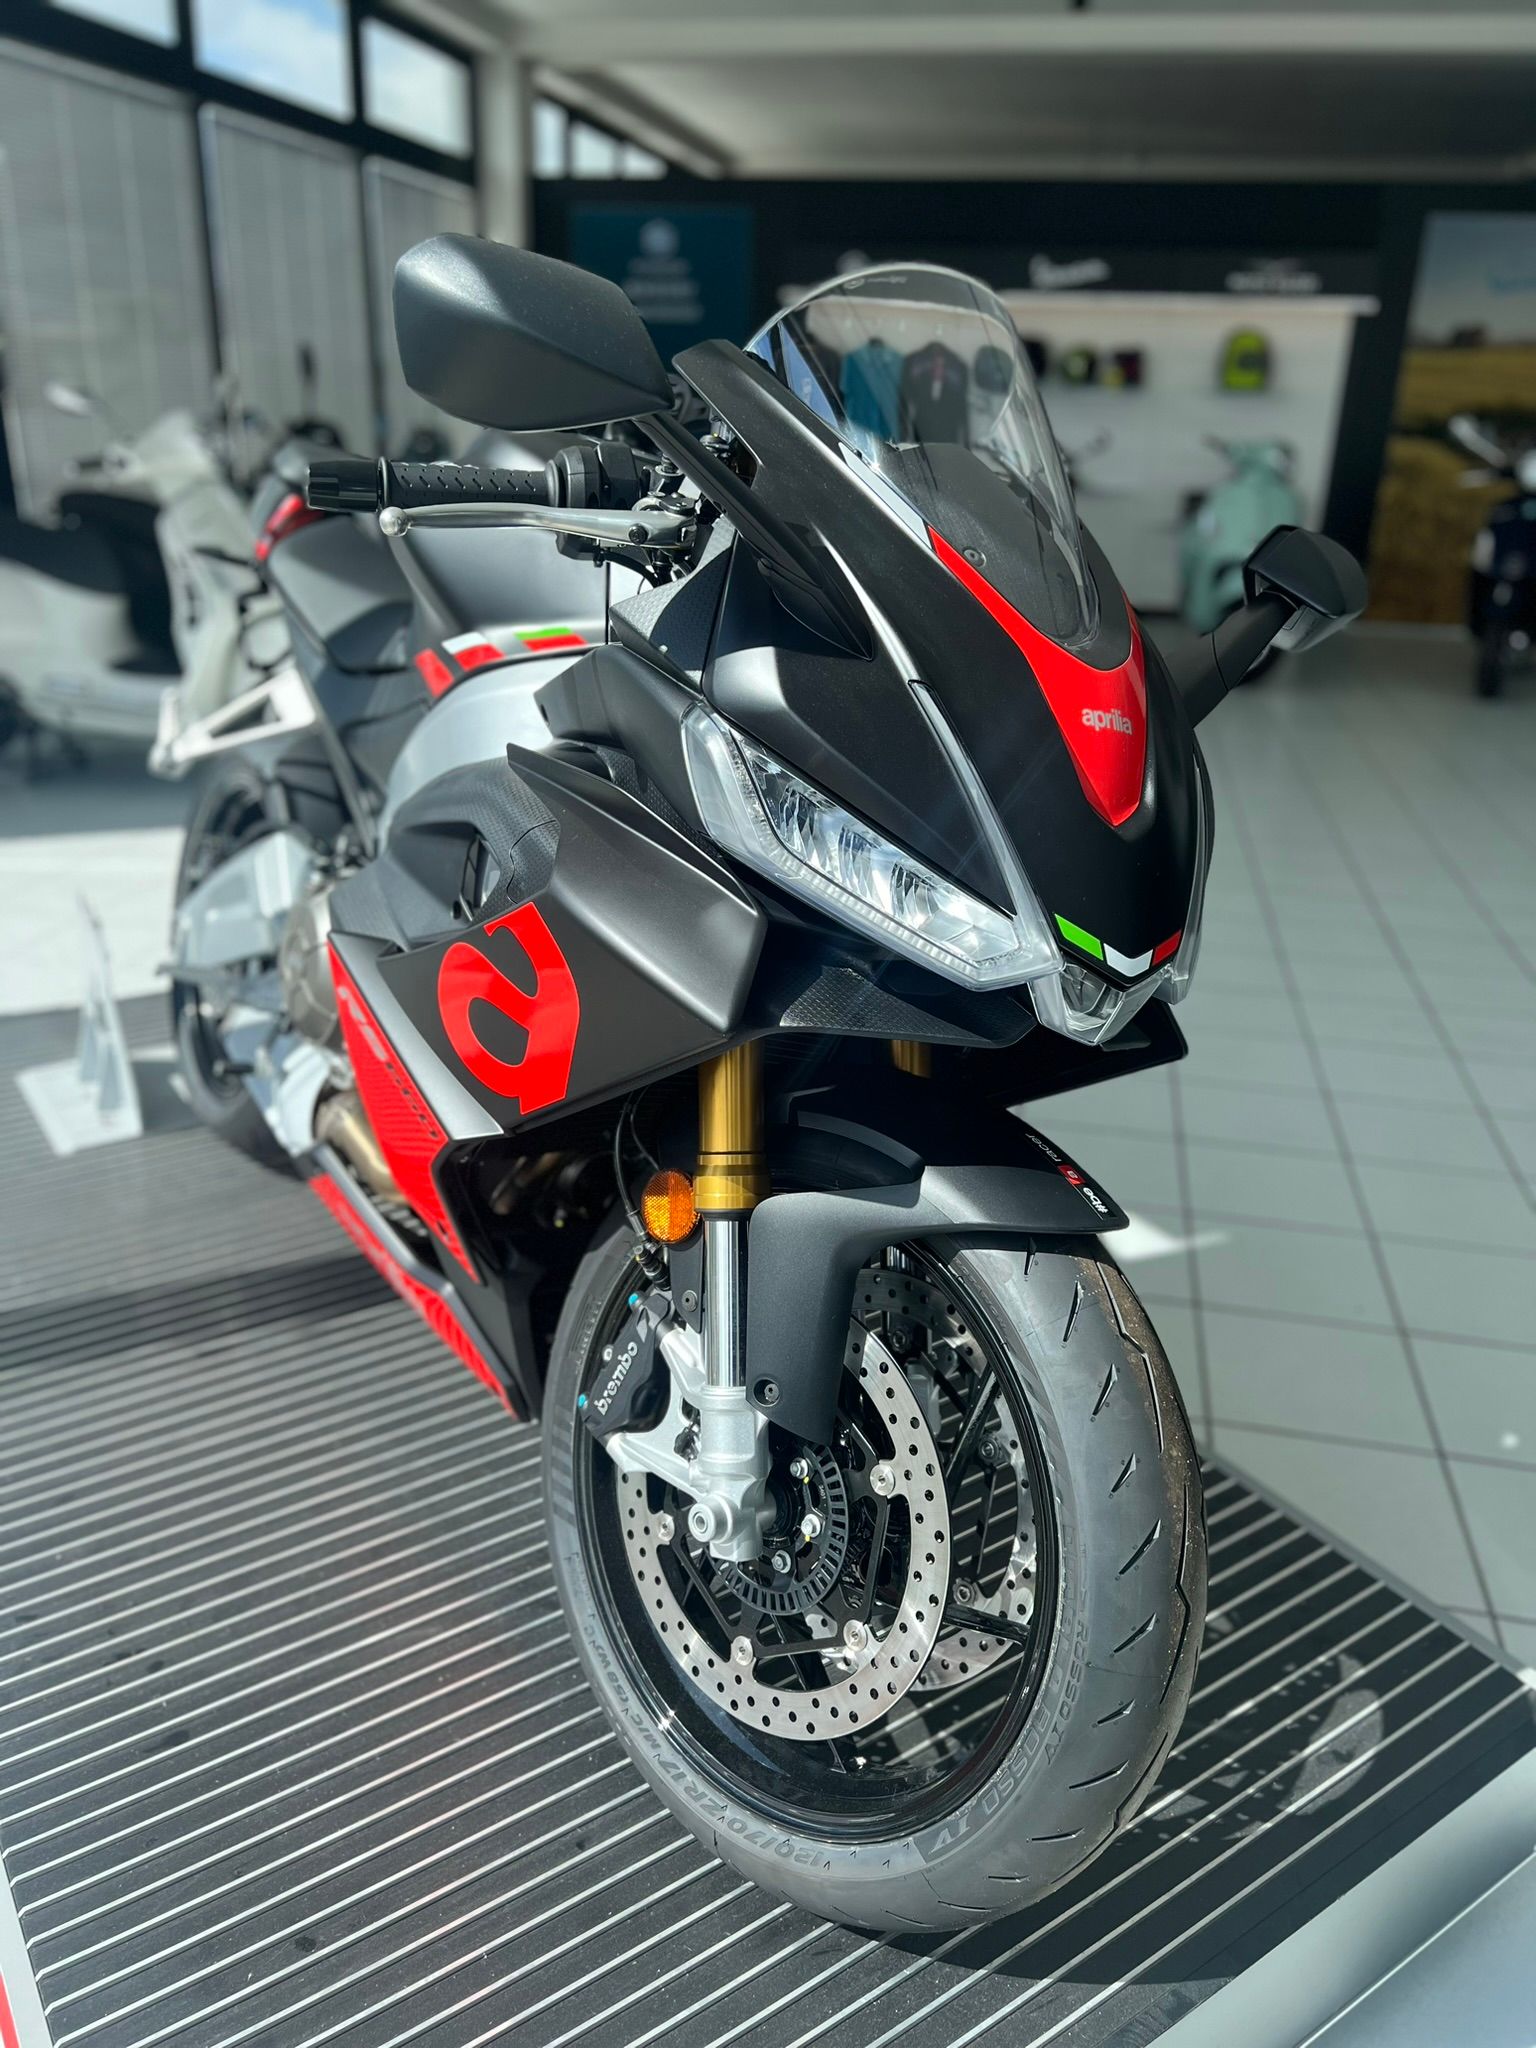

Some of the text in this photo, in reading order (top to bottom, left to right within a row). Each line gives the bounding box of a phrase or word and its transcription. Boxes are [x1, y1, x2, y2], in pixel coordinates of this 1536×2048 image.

[1081, 708, 1133, 735] aprilia
[1025, 1133, 1063, 1163] racer
[1083, 1187, 1110, 1215] #be
[593, 1341, 638, 1416] brembo
[928, 1815, 972, 1855] IV
